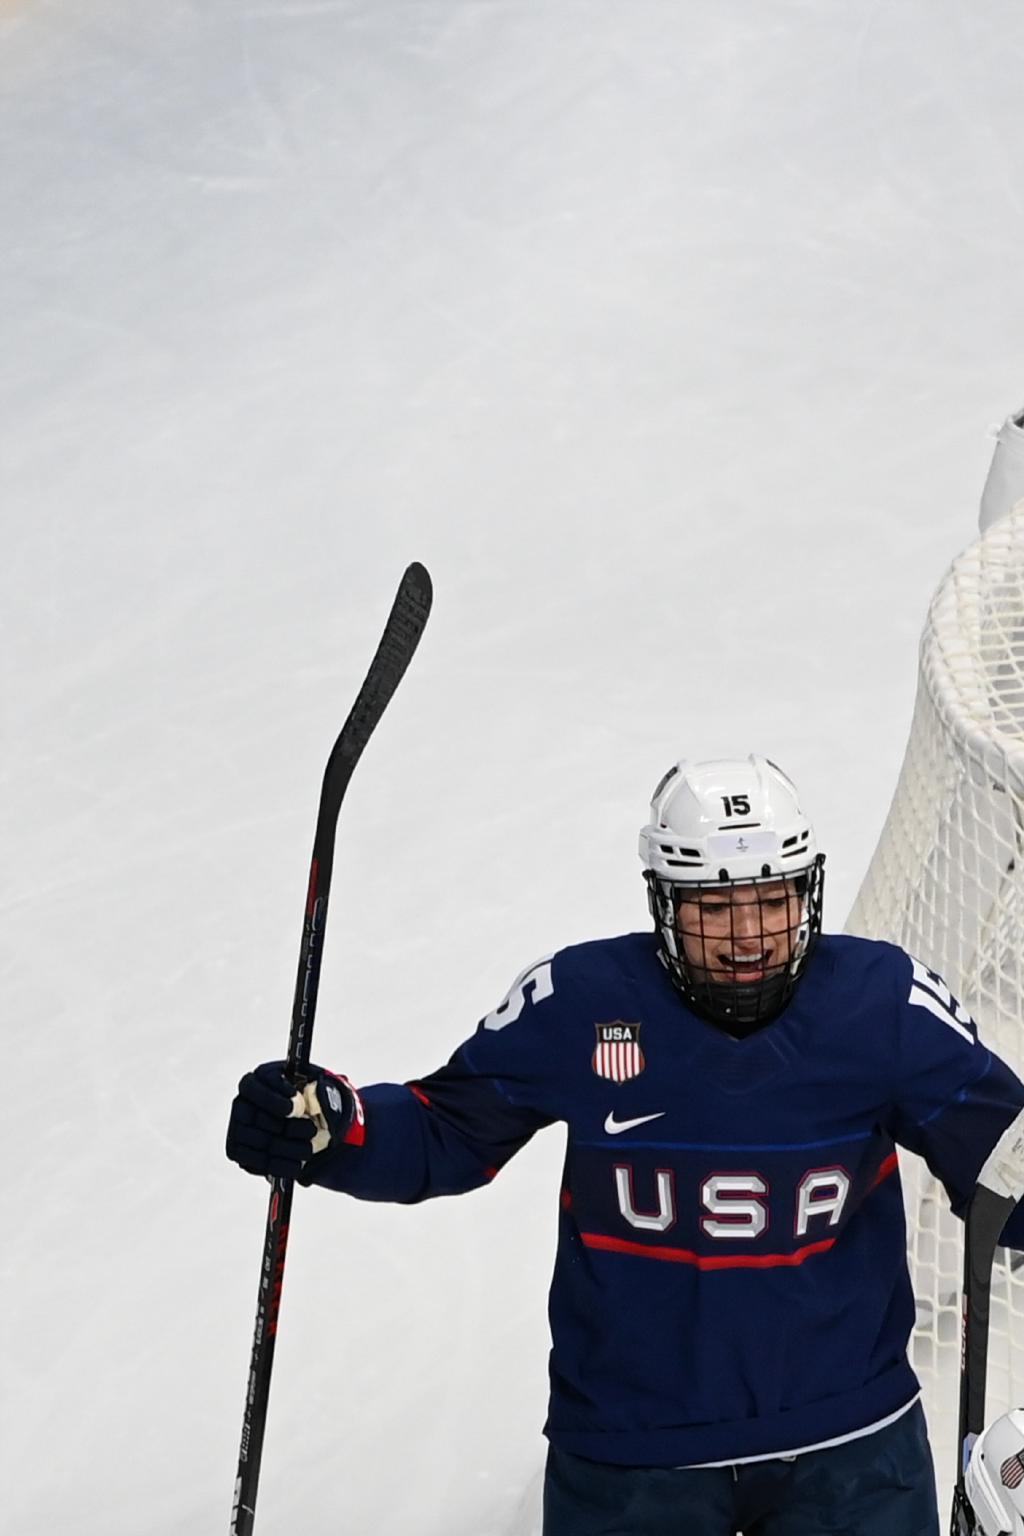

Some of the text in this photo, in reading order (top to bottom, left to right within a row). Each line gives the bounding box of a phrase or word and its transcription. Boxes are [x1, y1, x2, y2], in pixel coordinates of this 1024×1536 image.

[720, 794, 751, 817] 15
[603, 1027, 632, 1041] USA
[613, 1164, 851, 1239] USA
